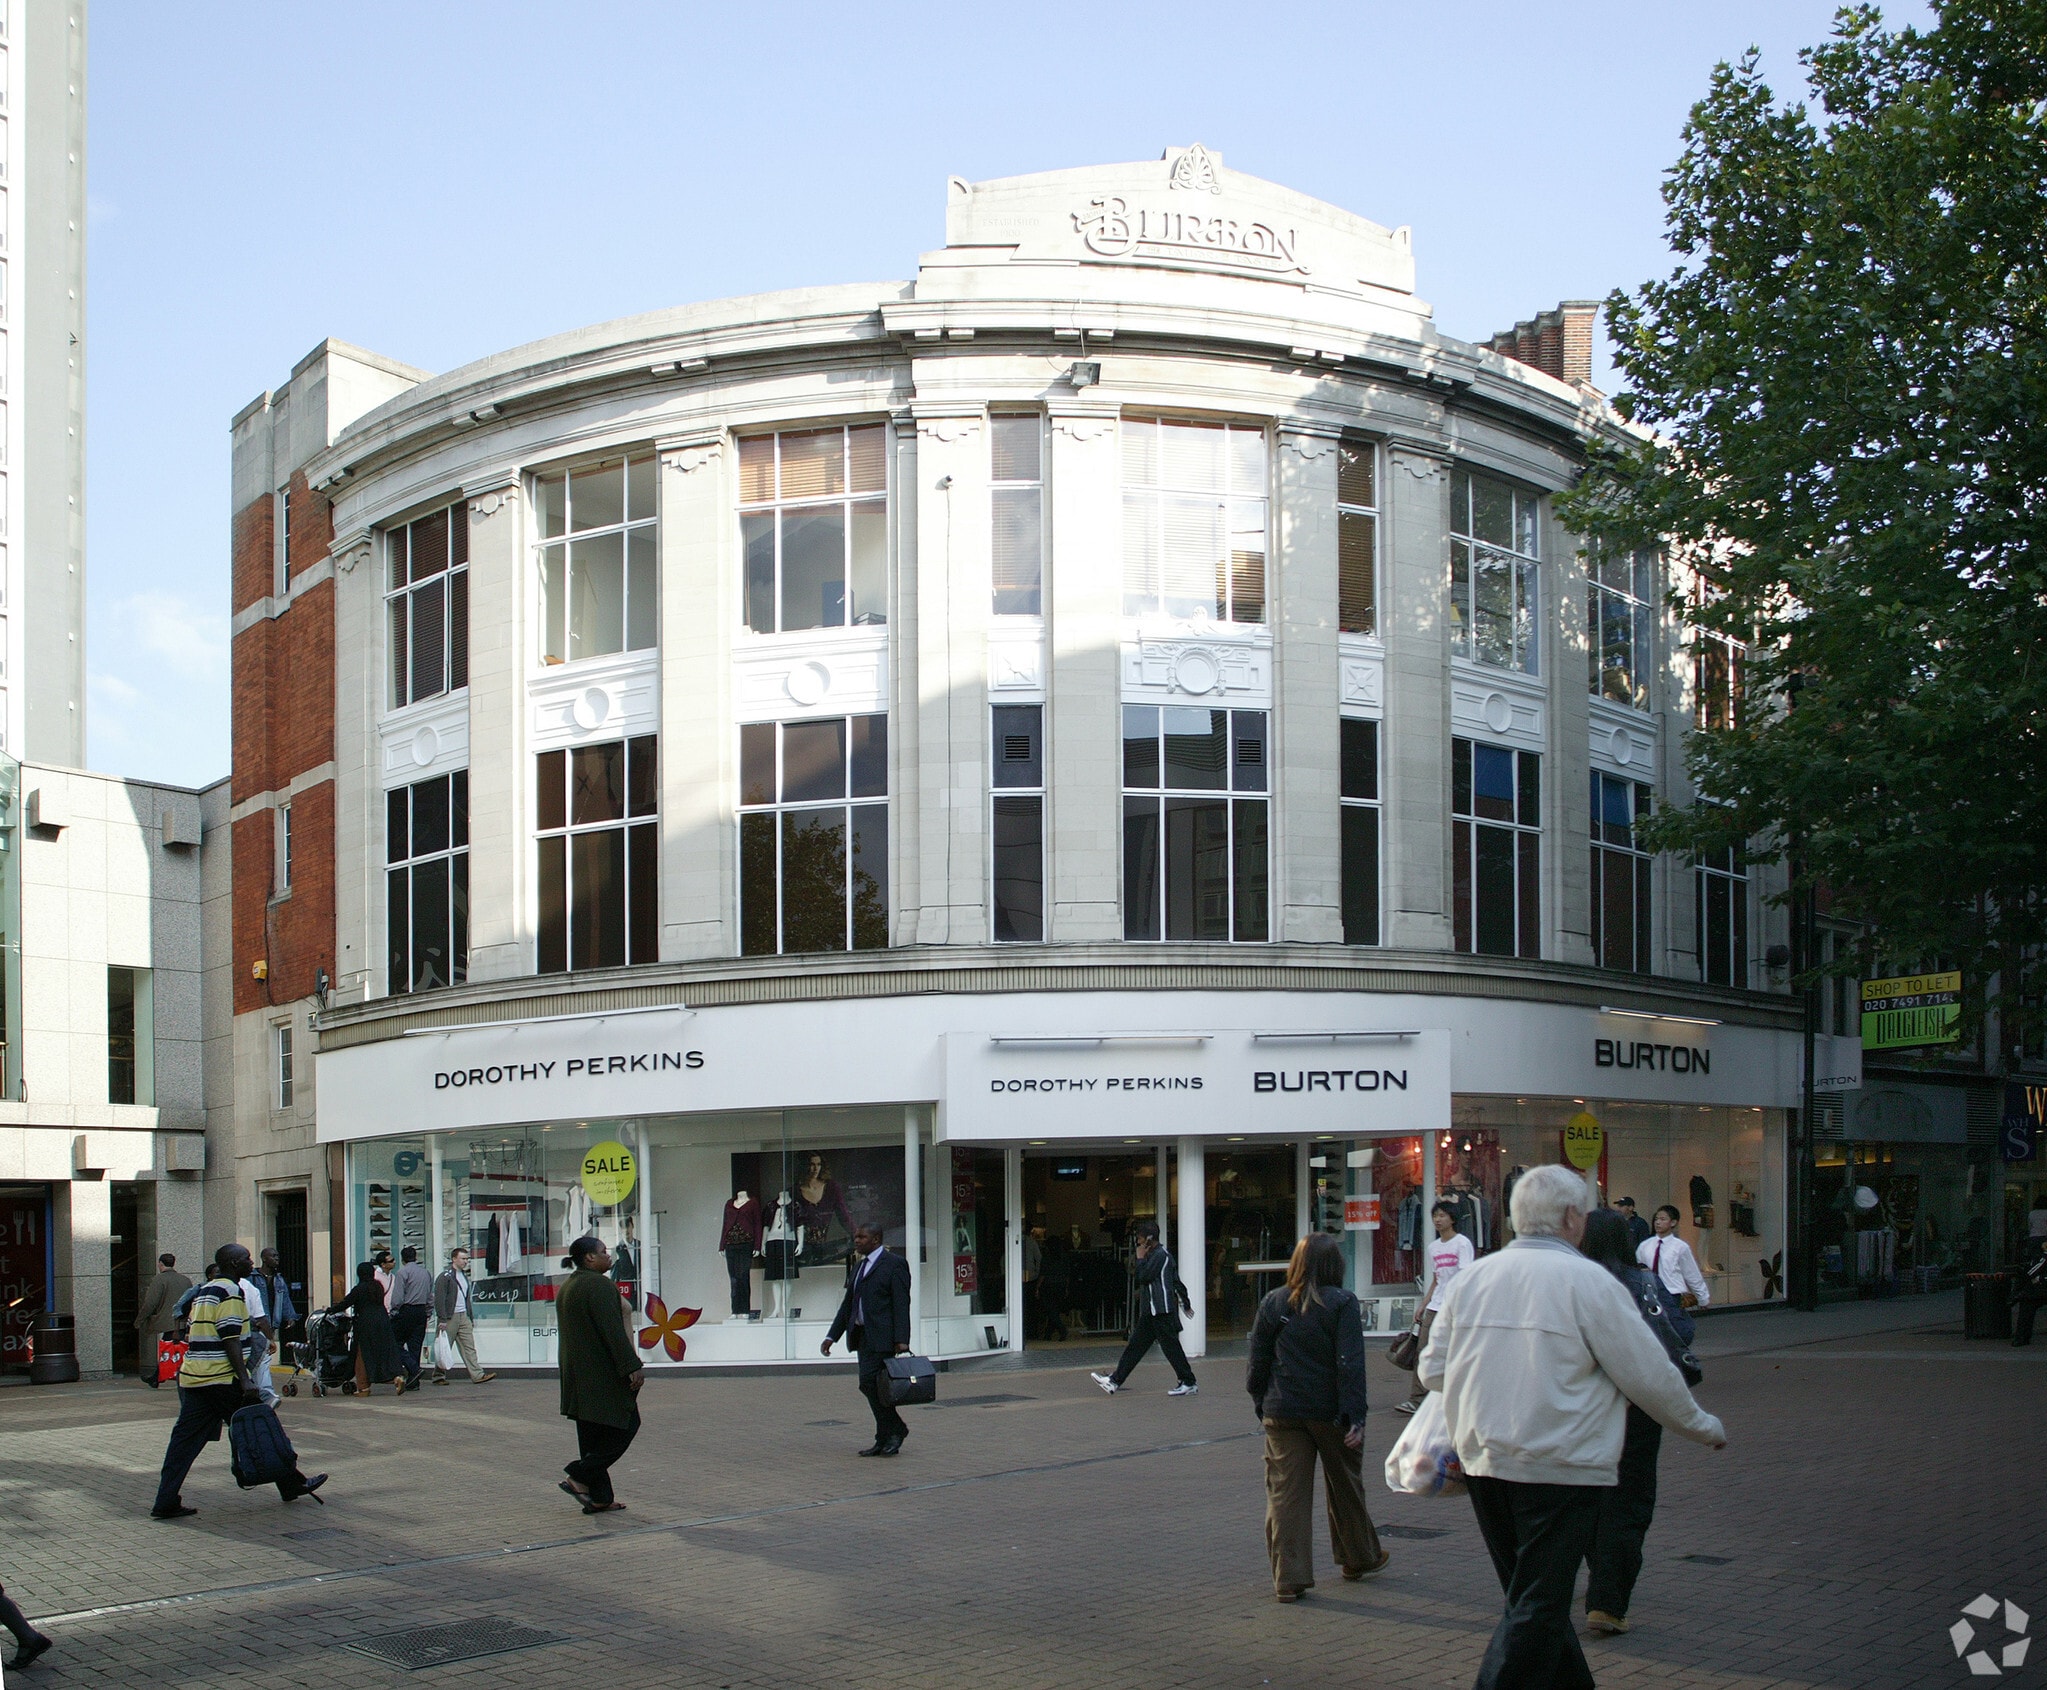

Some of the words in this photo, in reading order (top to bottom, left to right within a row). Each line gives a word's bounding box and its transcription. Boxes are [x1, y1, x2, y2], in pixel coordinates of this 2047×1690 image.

[1866, 982, 1901, 998] SHOP
[1906, 979, 1923, 993] TO
[1927, 975, 1953, 991] LET
[1864, 1000, 1887, 1011] 020
[1892, 996, 1921, 1008] 7491
[1595, 1039, 1709, 1074] BURTON
[435, 1061, 557, 1090] DOROTHY
[566, 1051, 704, 1077] PERKINS
[991, 1079, 1098, 1092] DOROTHY
[1106, 1077, 1203, 1090] PERKINS
[1254, 1070, 1407, 1092] BURTON
[1802, 1076, 1857, 1088] URTON
[1568, 1127, 1599, 1140] SALE
[585, 1156, 630, 1174] SALE
[1347, 1210, 1363, 1218] 15%
